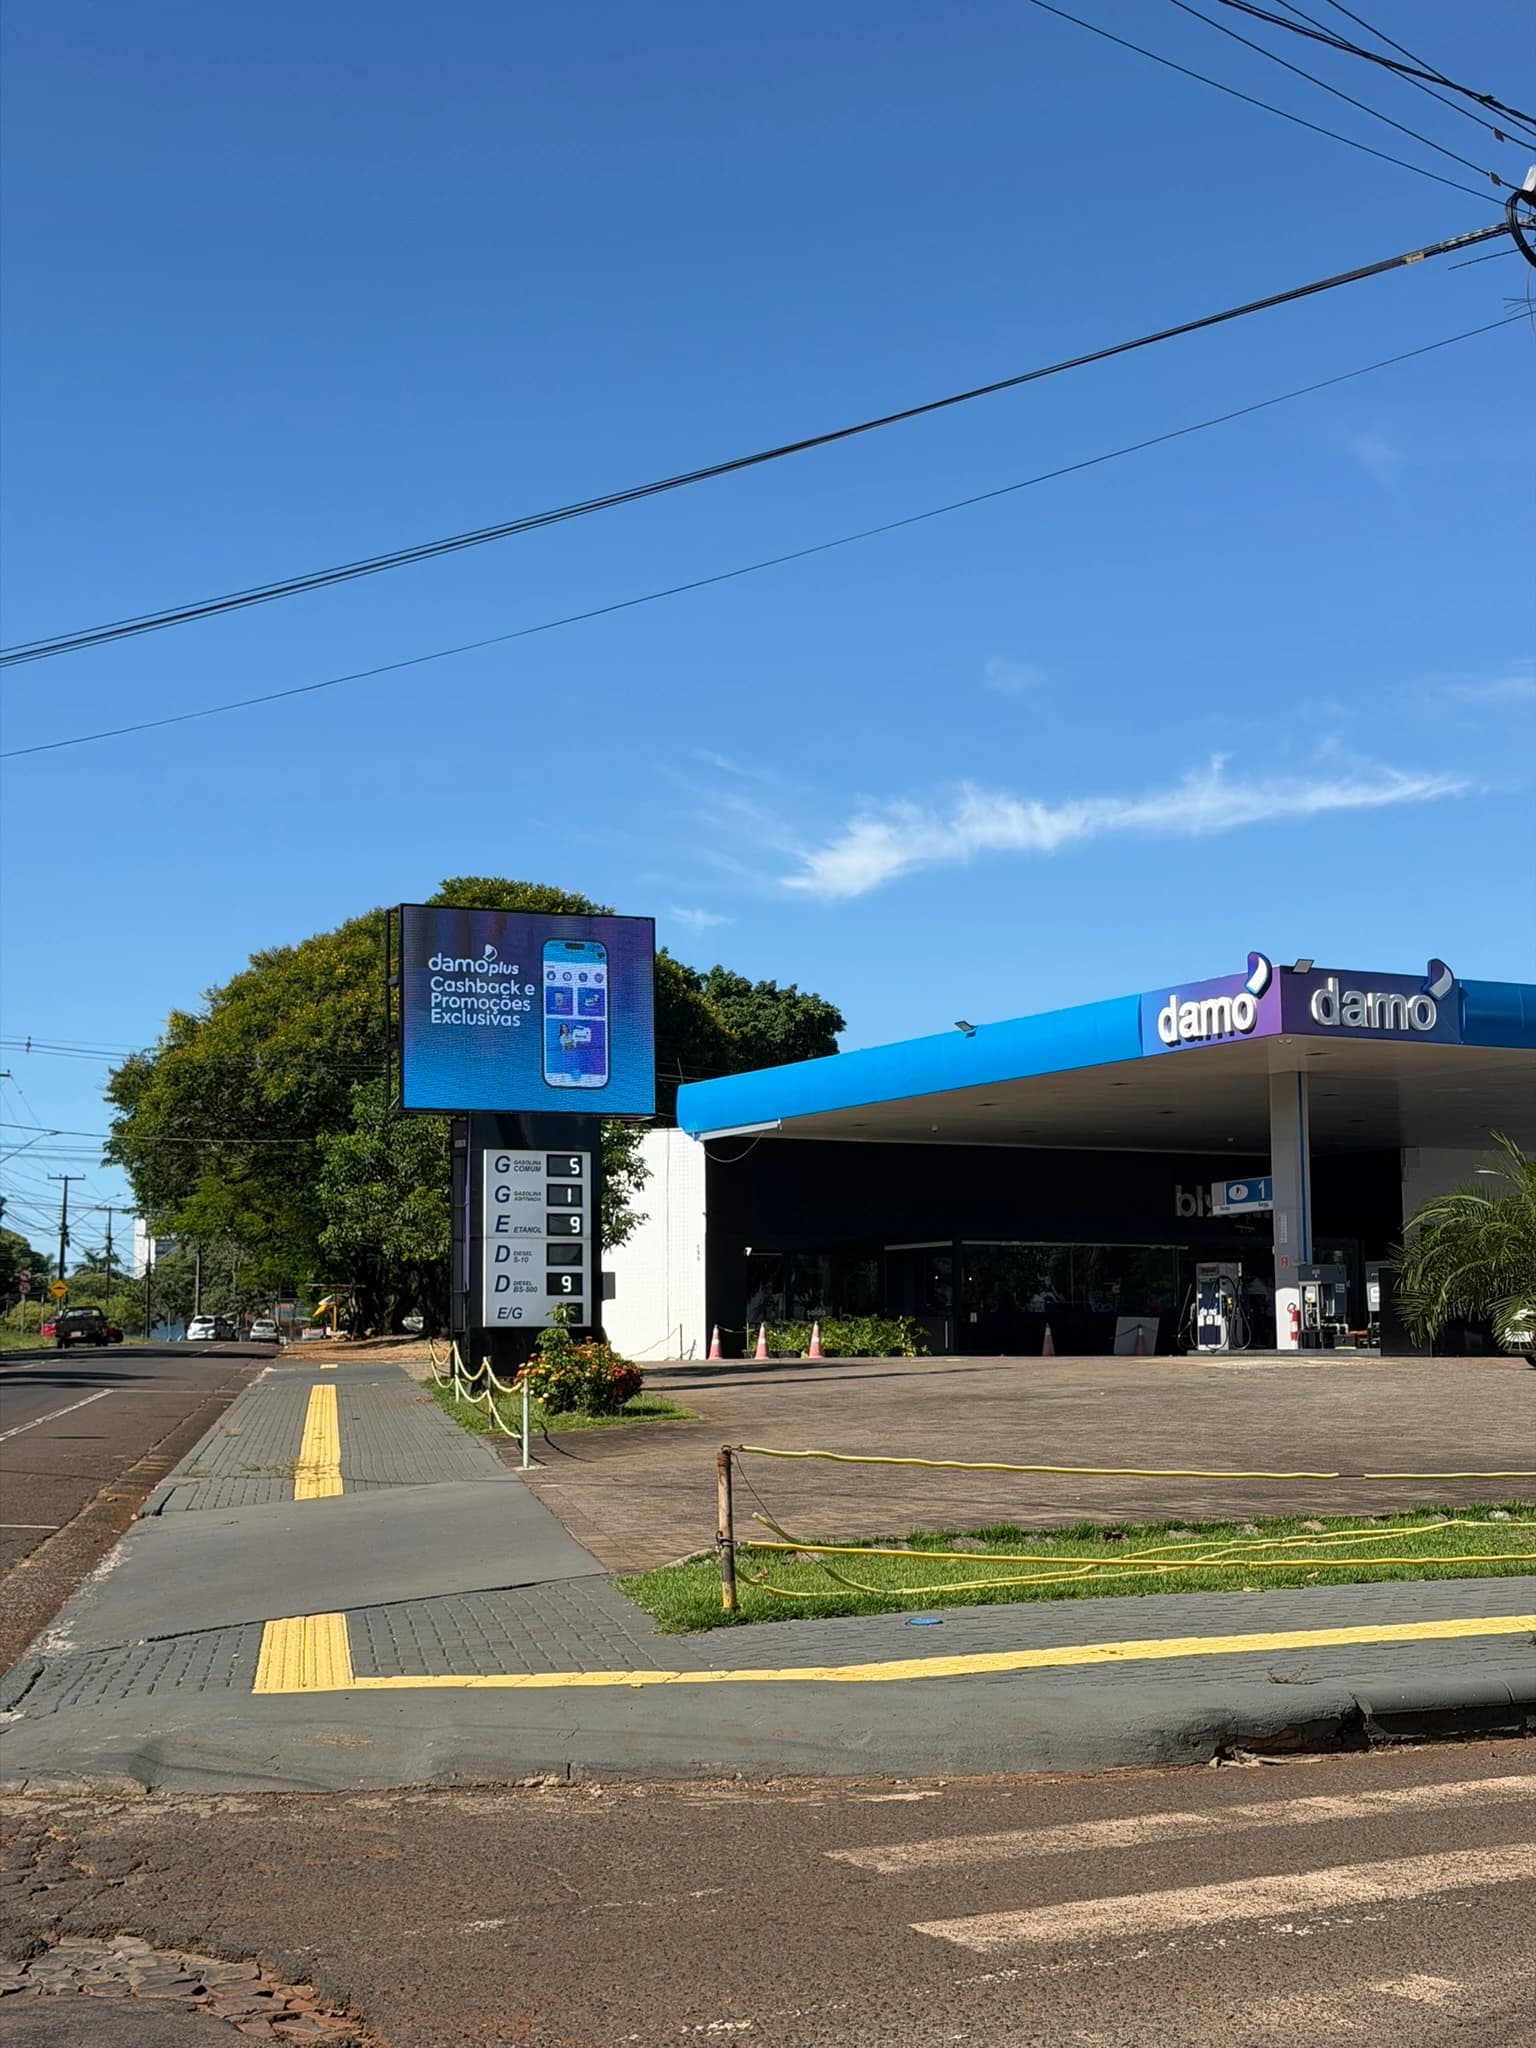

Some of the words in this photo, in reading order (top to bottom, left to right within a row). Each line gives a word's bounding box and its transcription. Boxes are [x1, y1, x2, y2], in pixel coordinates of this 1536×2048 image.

[430, 976, 520, 995] Cashback
[524, 983, 536, 996] e
[431, 993, 531, 1014] Promoções
[1311, 976, 1437, 1031] damo
[431, 1009, 521, 1027] Exclusivas
[1157, 994, 1257, 1043] damo
[495, 1155, 511, 1173] G
[495, 1185, 511, 1203] G
[1258, 1180, 1265, 1199] 1
[495, 1214, 511, 1233] E
[513, 1226, 542, 1234] ETANOL
[570, 1216, 581, 1234] 9
[494, 1245, 510, 1263] D
[494, 1274, 510, 1293] D
[561, 1275, 572, 1293] 9
[497, 1306, 523, 1320] E/G
